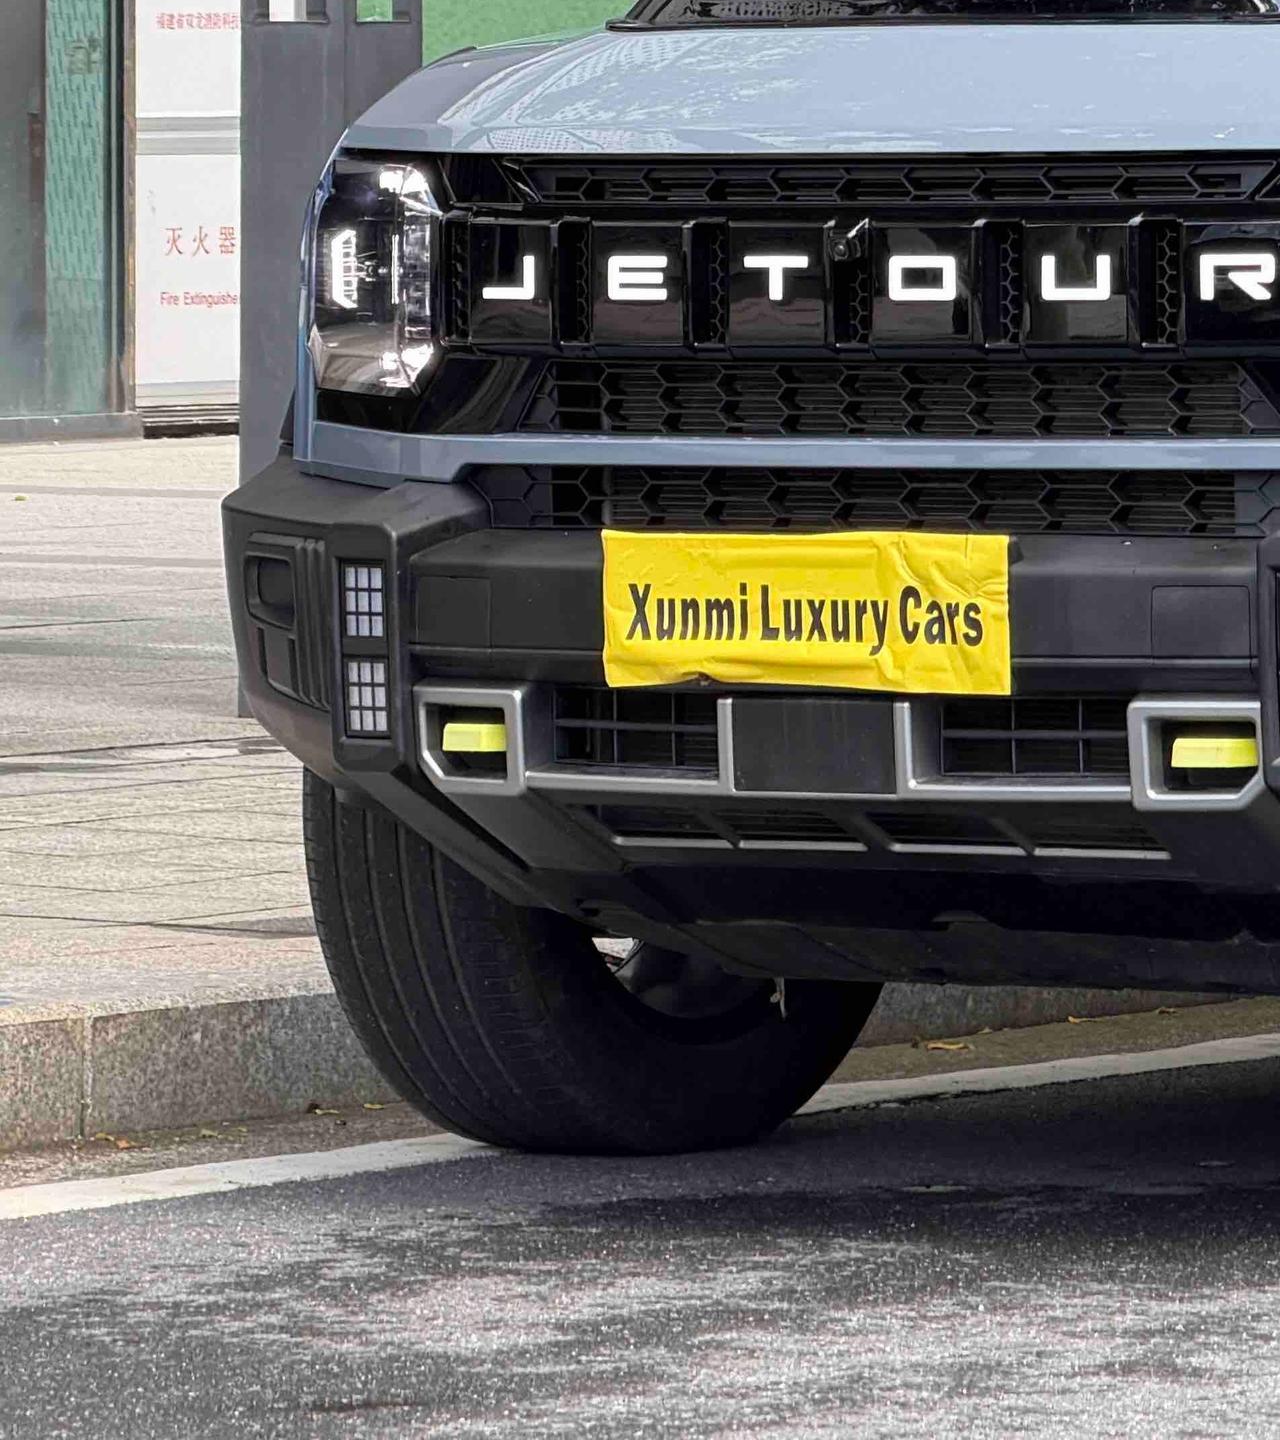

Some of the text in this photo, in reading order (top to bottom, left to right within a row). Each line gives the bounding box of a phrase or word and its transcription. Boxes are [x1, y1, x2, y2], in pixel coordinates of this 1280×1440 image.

[164, 225, 237, 257] 灭火器
[481, 252, 1277, 302] JETOUR
[160, 291, 180, 306] Fire
[625, 582, 984, 657] Xunmi Luxury Cars
